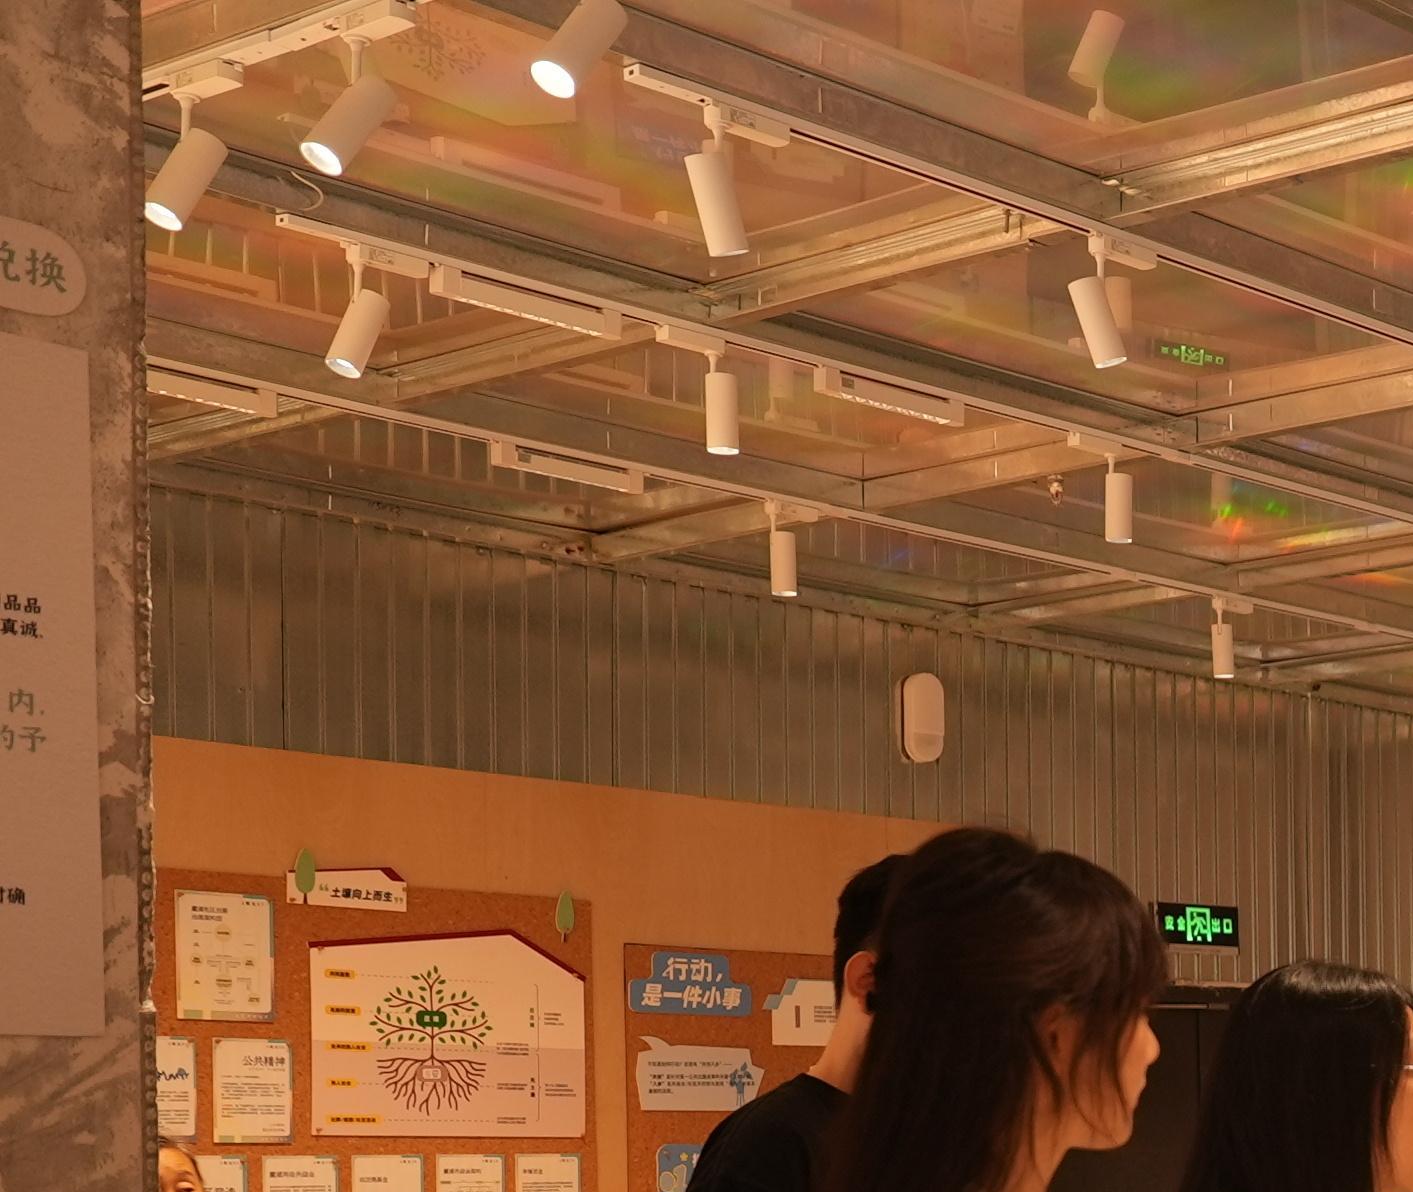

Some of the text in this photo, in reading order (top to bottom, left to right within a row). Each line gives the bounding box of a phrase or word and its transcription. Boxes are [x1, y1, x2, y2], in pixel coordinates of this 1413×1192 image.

[0, 594, 42, 614] 品品
[0, 886, 26, 905] 确
[1211, 917, 1233, 934] 出口
[640, 983, 743, 1011] 是一件小事
